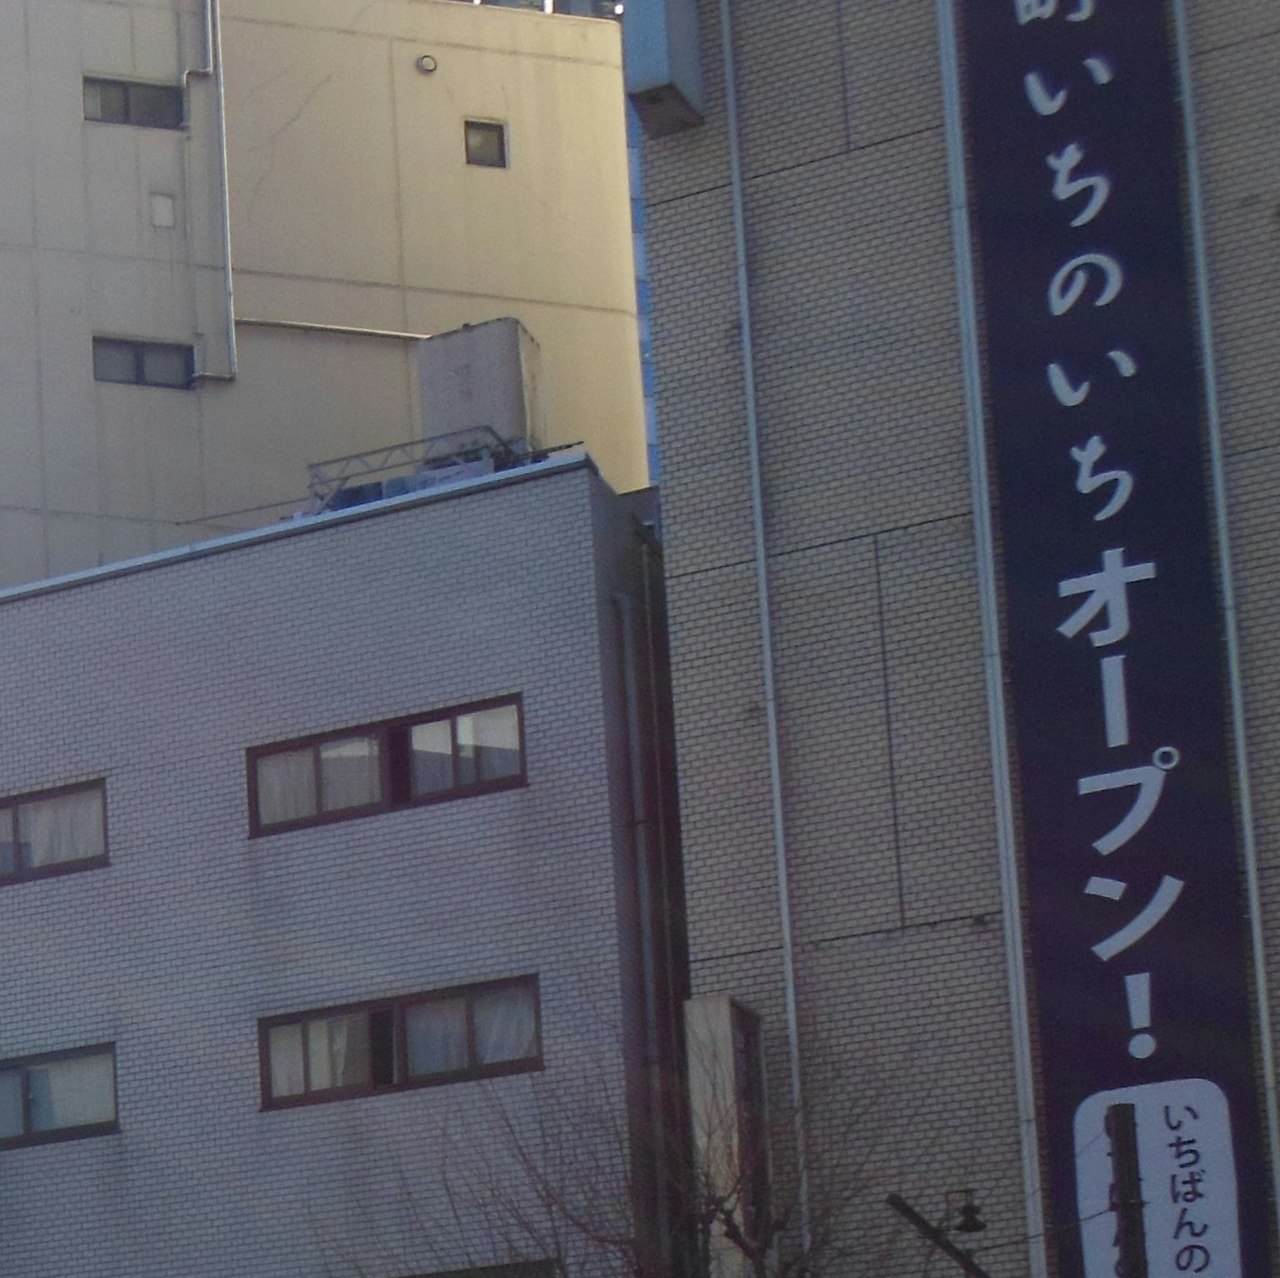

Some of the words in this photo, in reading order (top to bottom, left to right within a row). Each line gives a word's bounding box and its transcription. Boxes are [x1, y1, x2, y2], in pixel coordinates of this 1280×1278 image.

[1016, 0, 1185, 1059] いちのいちオープン!
